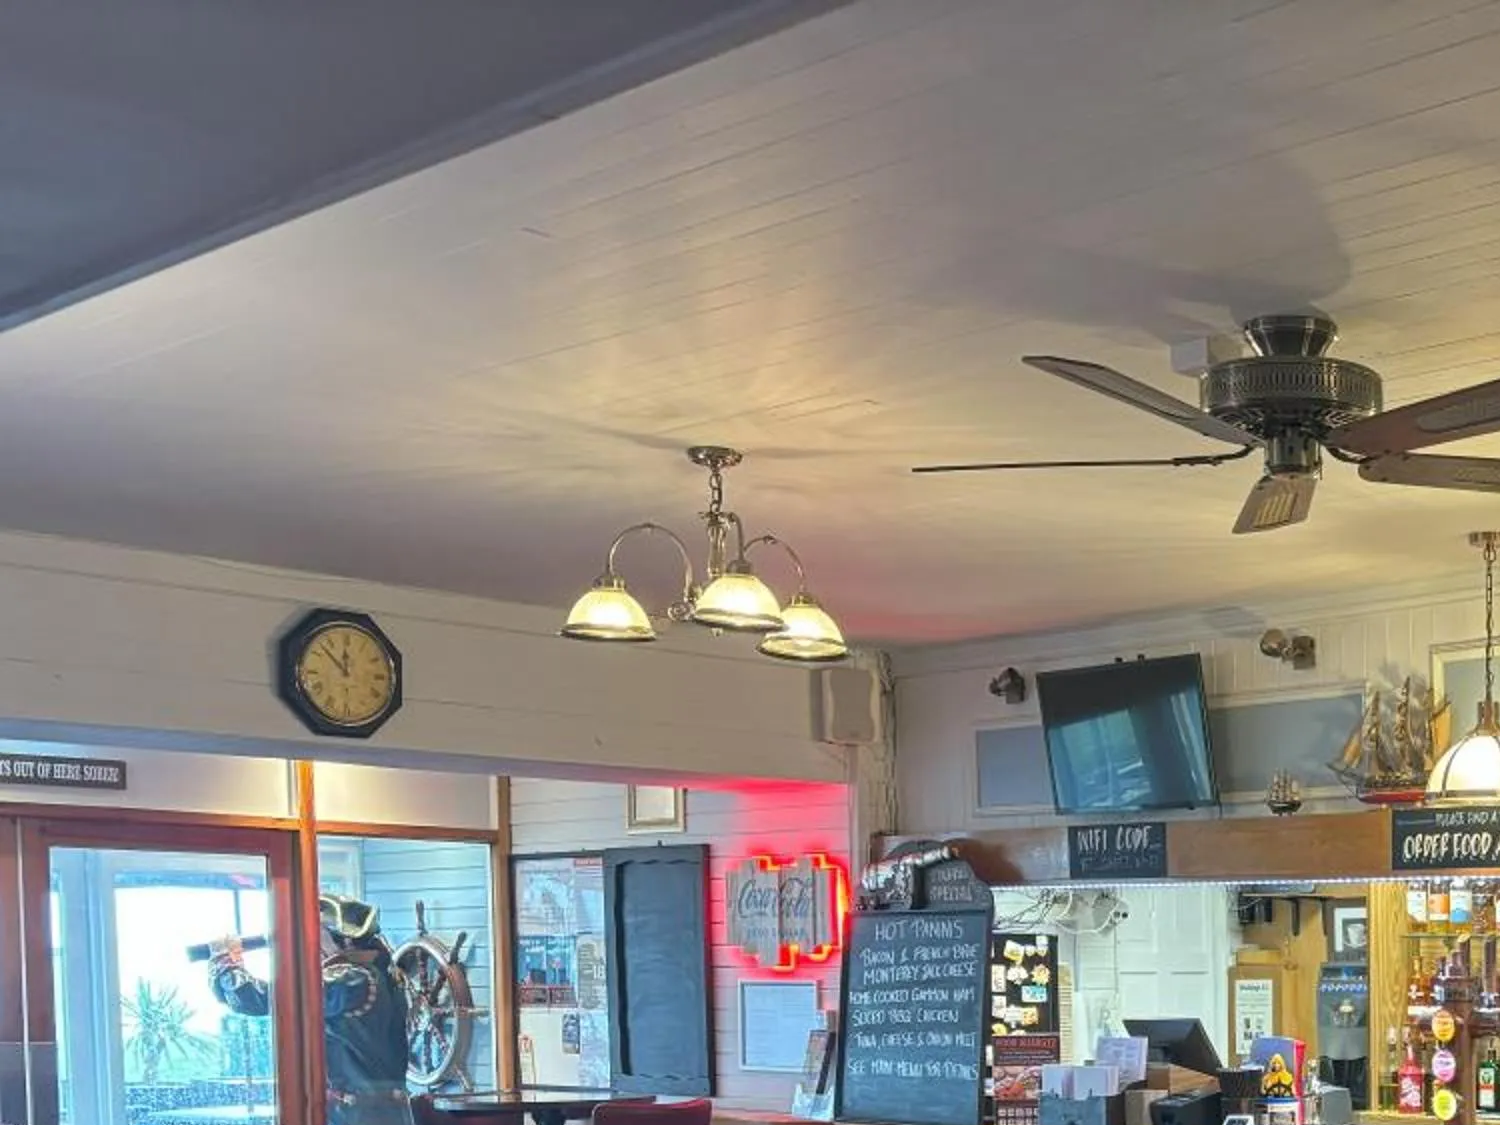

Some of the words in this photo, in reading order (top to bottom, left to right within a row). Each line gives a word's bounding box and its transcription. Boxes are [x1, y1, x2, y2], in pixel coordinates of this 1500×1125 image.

[14, 761, 34, 777] OUT
[37, 762, 51, 779] OF
[1403, 831, 1450, 861] ORDER
[1453, 831, 1493, 858] FOOD
[875, 920, 908, 940] HOT
